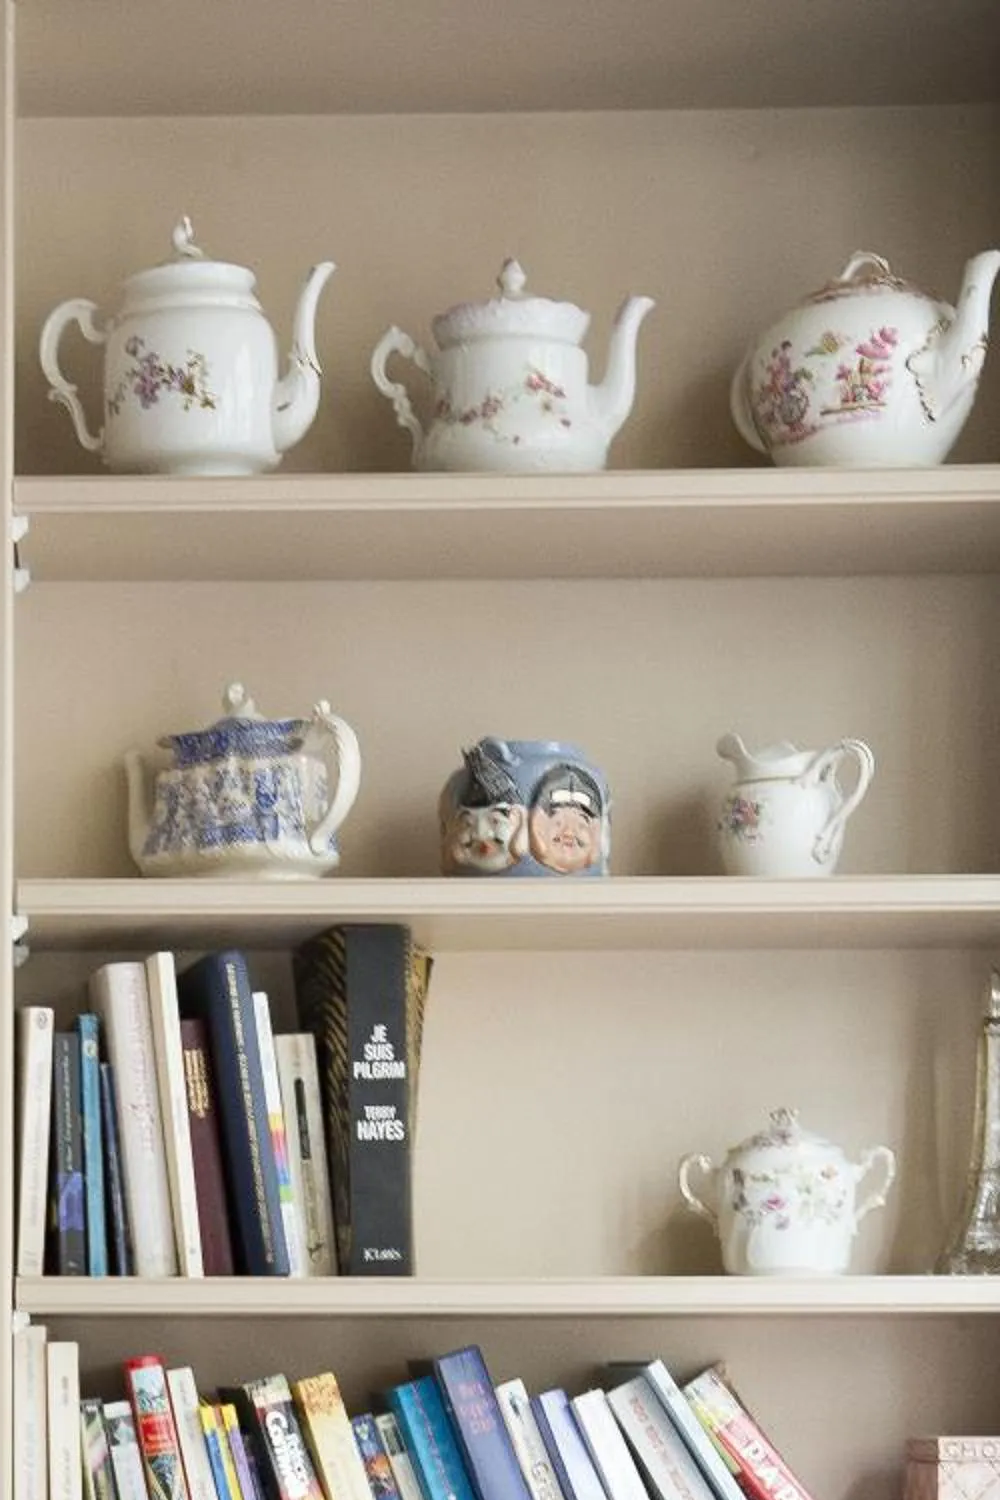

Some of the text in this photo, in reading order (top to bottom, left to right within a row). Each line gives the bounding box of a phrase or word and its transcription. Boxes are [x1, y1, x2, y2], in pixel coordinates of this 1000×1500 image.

[371, 1024, 388, 1043] JE
[363, 1043, 395, 1061] SUIS
[353, 1061, 406, 1080] PILGRIM
[356, 1119, 405, 1142] HAYES
